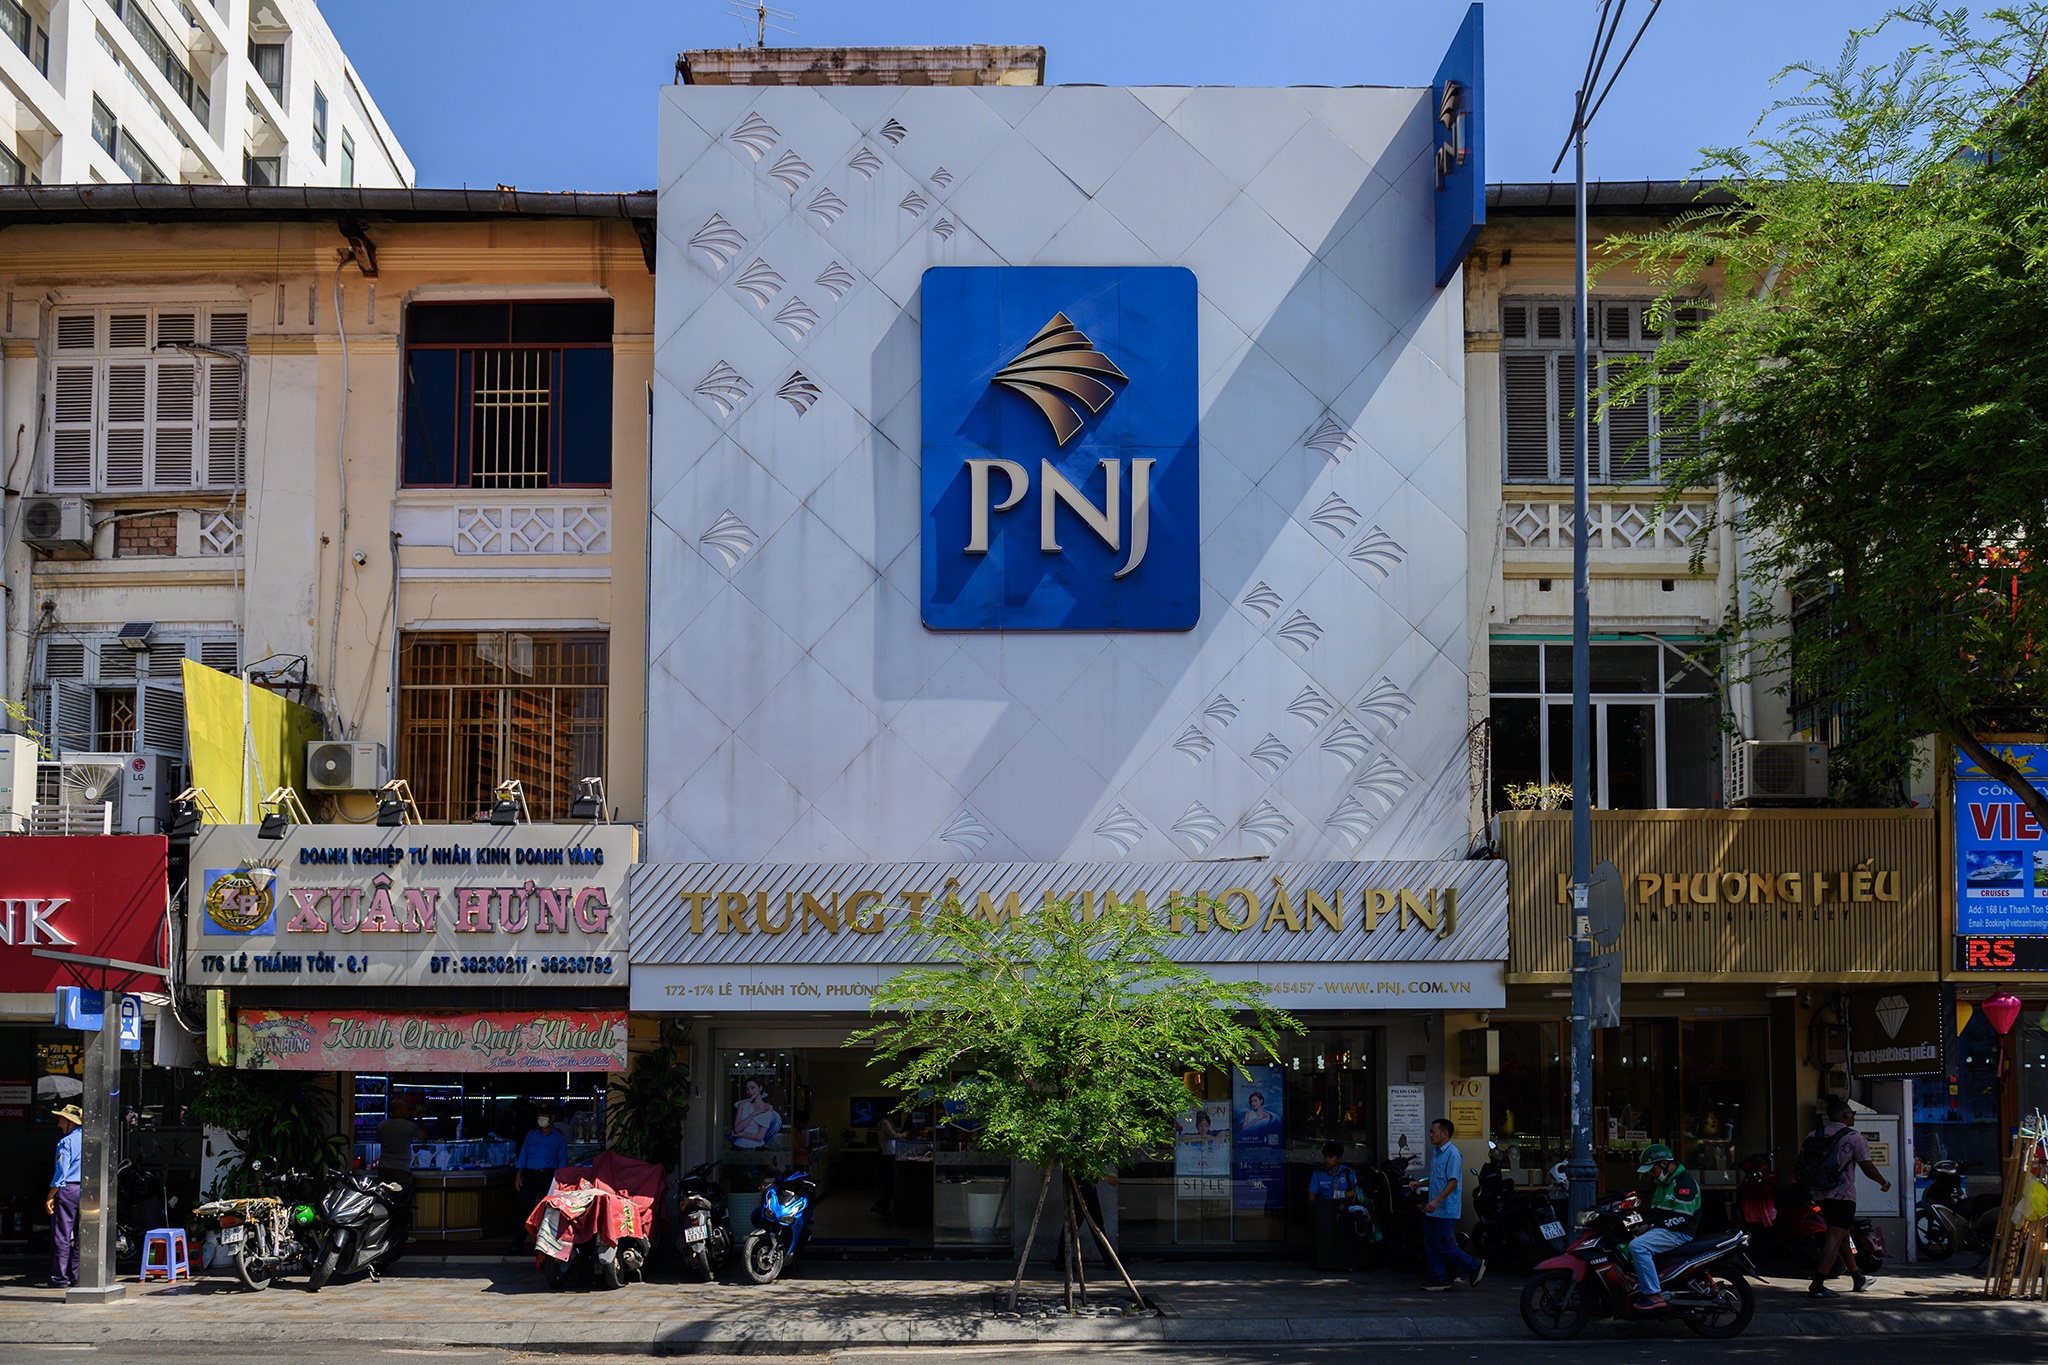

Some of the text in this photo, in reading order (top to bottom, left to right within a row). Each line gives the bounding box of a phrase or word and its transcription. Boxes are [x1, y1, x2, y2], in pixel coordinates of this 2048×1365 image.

[1436, 111, 1466, 191] PNJ
[964, 458, 1157, 578] PNJ
[1978, 785, 2013, 796] CÔN
[300, 844, 604, 868] DOANH NGHIỆP TƯ NHÂN KINH DOANH VÀNG
[1638, 867, 1802, 908] PHƯƠNG
[1811, 857, 1900, 907] HIẾU
[286, 872, 612, 934] XUÂN HƯNG
[681, 890, 884, 935] TRUNG
[1170, 875, 1343, 932] HOÀN
[1365, 888, 1457, 939] PNJ
[1968, 905, 1984, 914] Add:
[1986, 905, 1997, 914] 168
[1999, 905, 2007, 914] Le
[2009, 905, 2030, 914] Thanh
[2031, 905, 2044, 914] Ton
[1633, 911, 1711, 922] AMOND
[1968, 918, 1984, 928] Email:
[202, 955, 225, 972] 176
[230, 952, 248, 972] LÊ
[254, 951, 302, 972] THÁNH
[306, 951, 335, 972] TÔN
[347, 955, 368, 974] Q.1
[1969, 940, 2015, 966] RS
[431, 957, 449, 973] ĐT
[460, 957, 527, 973] 38230211
[541, 957, 612, 974] 38230792
[665, 985, 685, 996] 172
[718, 982, 732, 996] LÊ
[738, 982, 784, 996] THÁNH
[791, 982, 821, 998] TÔN,
[254, 1032, 282, 1053] XUÂN
[323, 1017, 616, 1058] Kính Chào Quý Khách
[579, 1055, 612, 1067] 2022
[1853, 1041, 1936, 1064] KIM PHƯƠNG HIẾU
[1451, 1080, 1482, 1097] 170
[1183, 1179, 1224, 1190] STYLE
